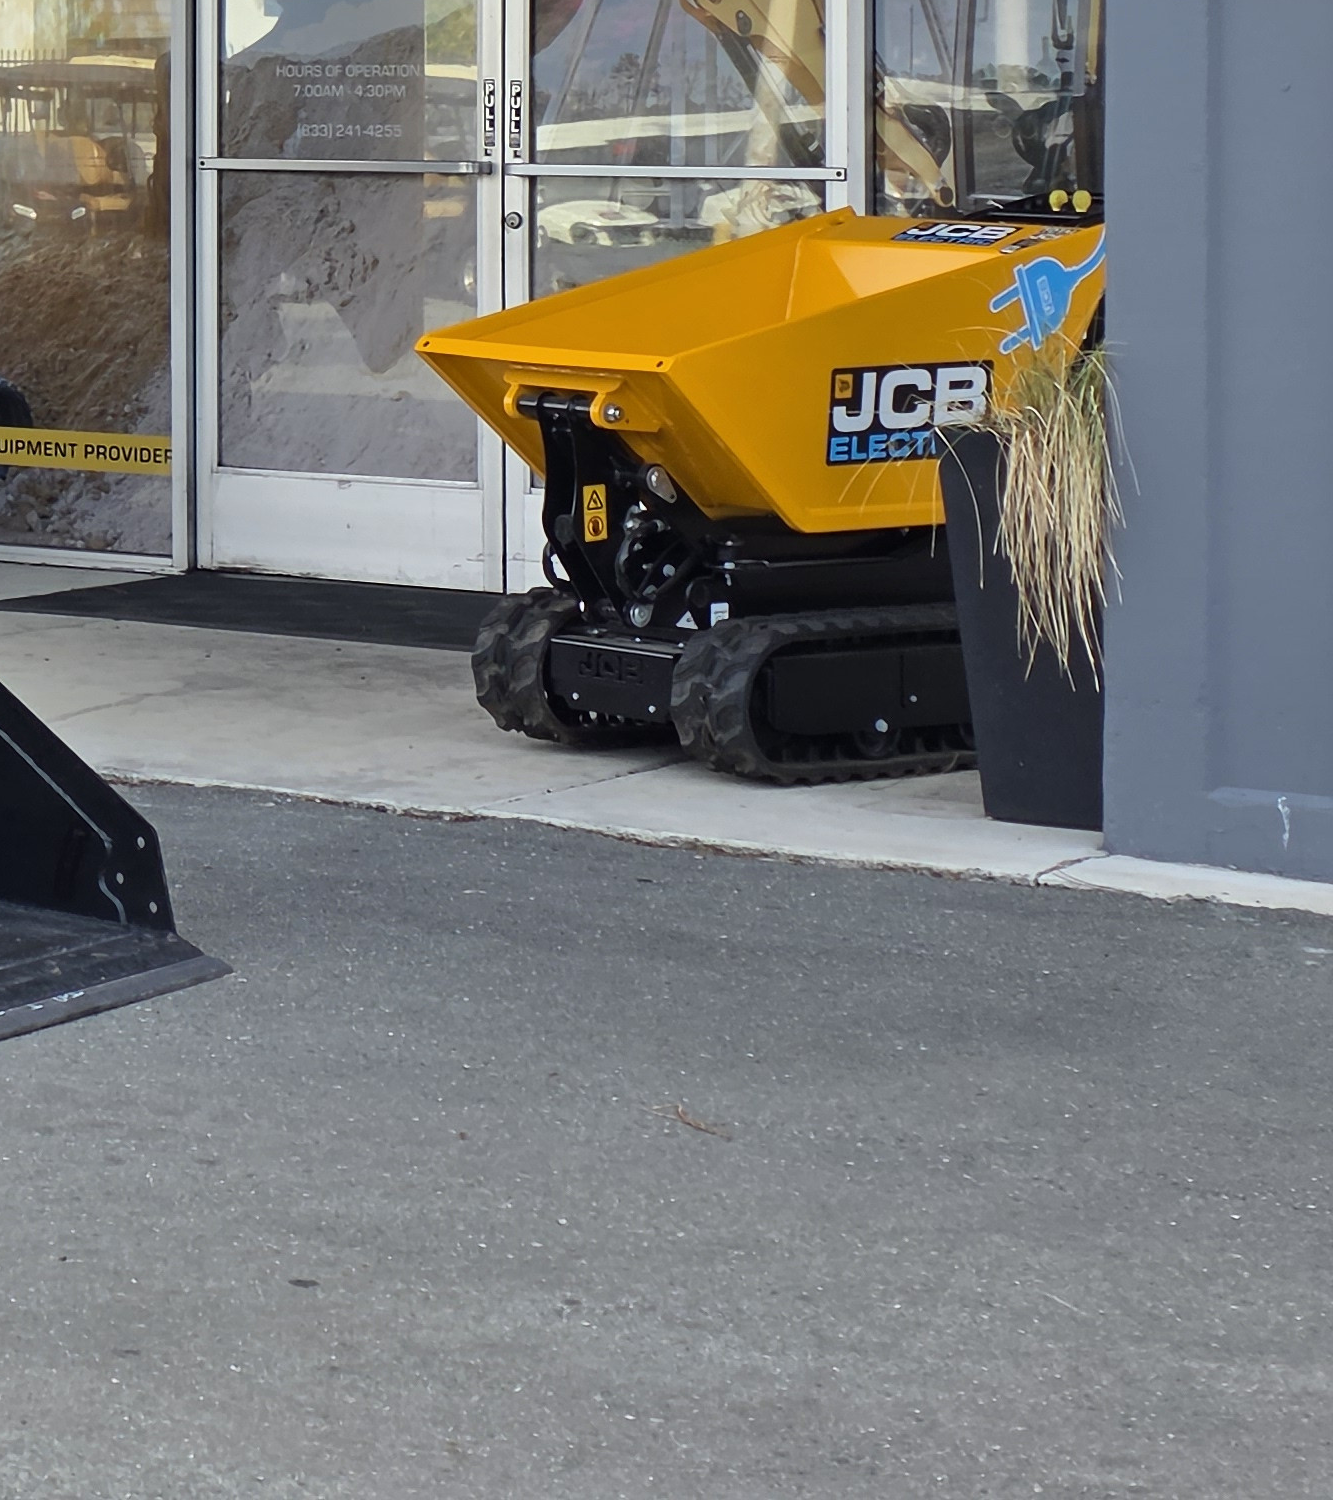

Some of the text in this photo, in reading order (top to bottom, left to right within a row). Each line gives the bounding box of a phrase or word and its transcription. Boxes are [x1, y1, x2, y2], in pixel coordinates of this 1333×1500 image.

[276, 63, 420, 78] HOURS OF OPERATION
[293, 84, 344, 98] 7:00AM
[354, 84, 406, 98] 4:30PM
[485, 83, 494, 132] PULL
[510, 84, 521, 133] PULL
[297, 123, 403, 139] (833) 241-4255
[906, 223, 1017, 240] JCB
[832, 366, 988, 434] JCB
[829, 431, 937, 462] ELECT
